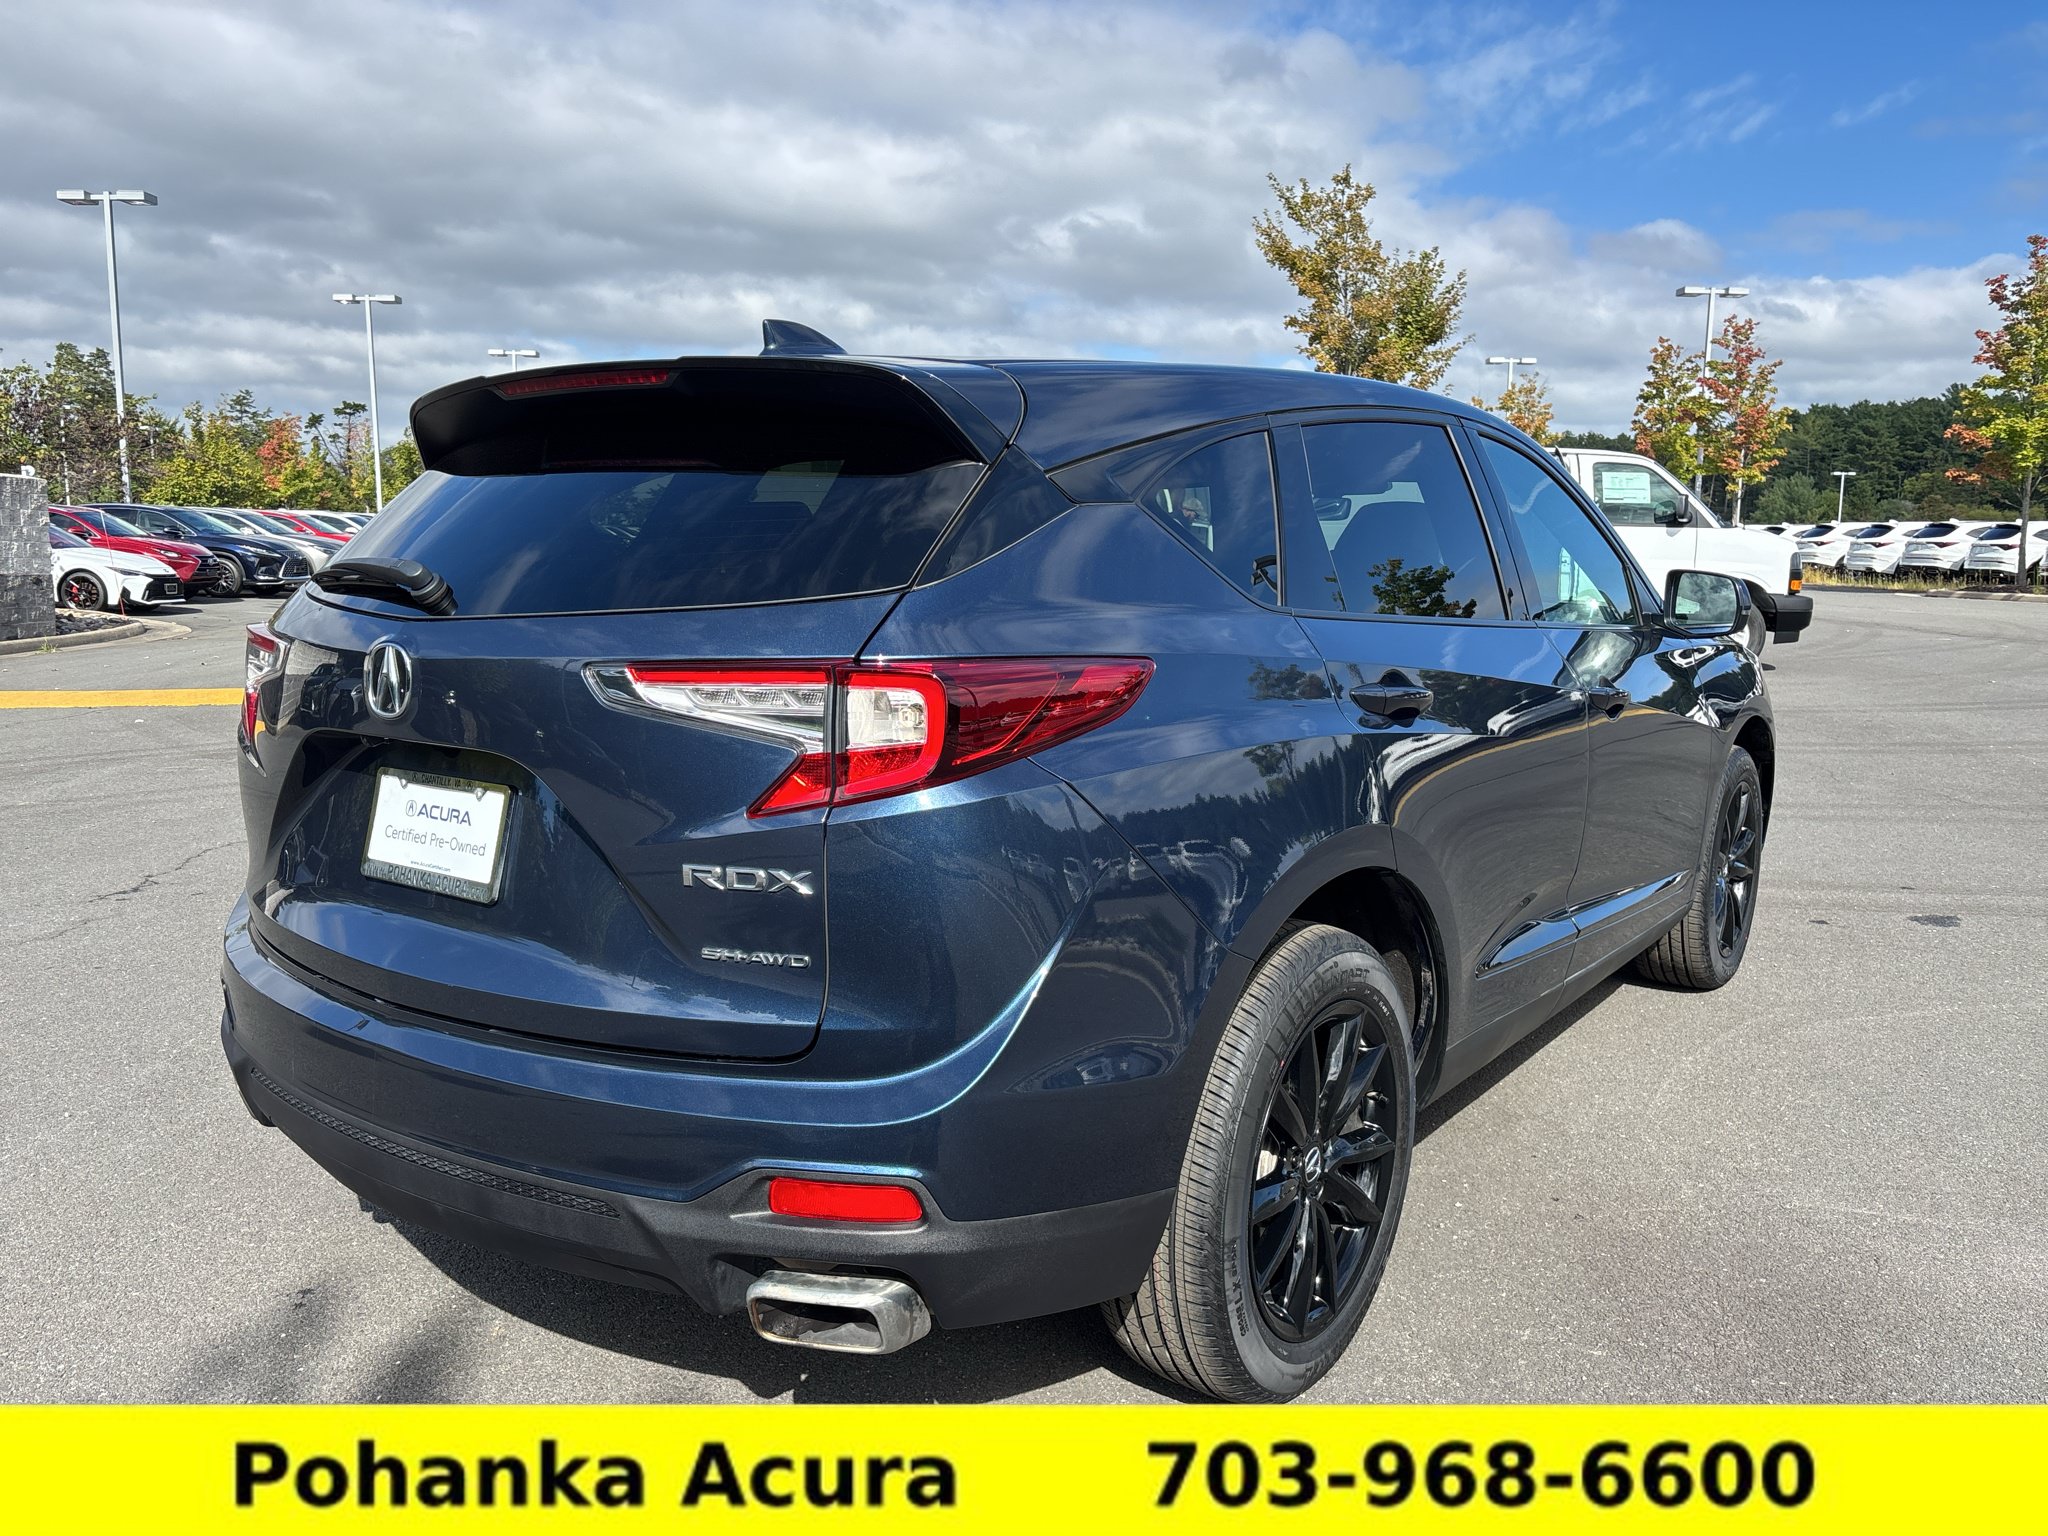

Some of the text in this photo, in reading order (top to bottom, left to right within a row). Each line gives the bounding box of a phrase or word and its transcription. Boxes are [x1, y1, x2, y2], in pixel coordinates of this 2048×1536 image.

[417, 803, 471, 826] ACURA
[385, 824, 487, 857] Certified Pre-Owned
[682, 864, 813, 896] RDX
[701, 947, 811, 968] SH-AWD
